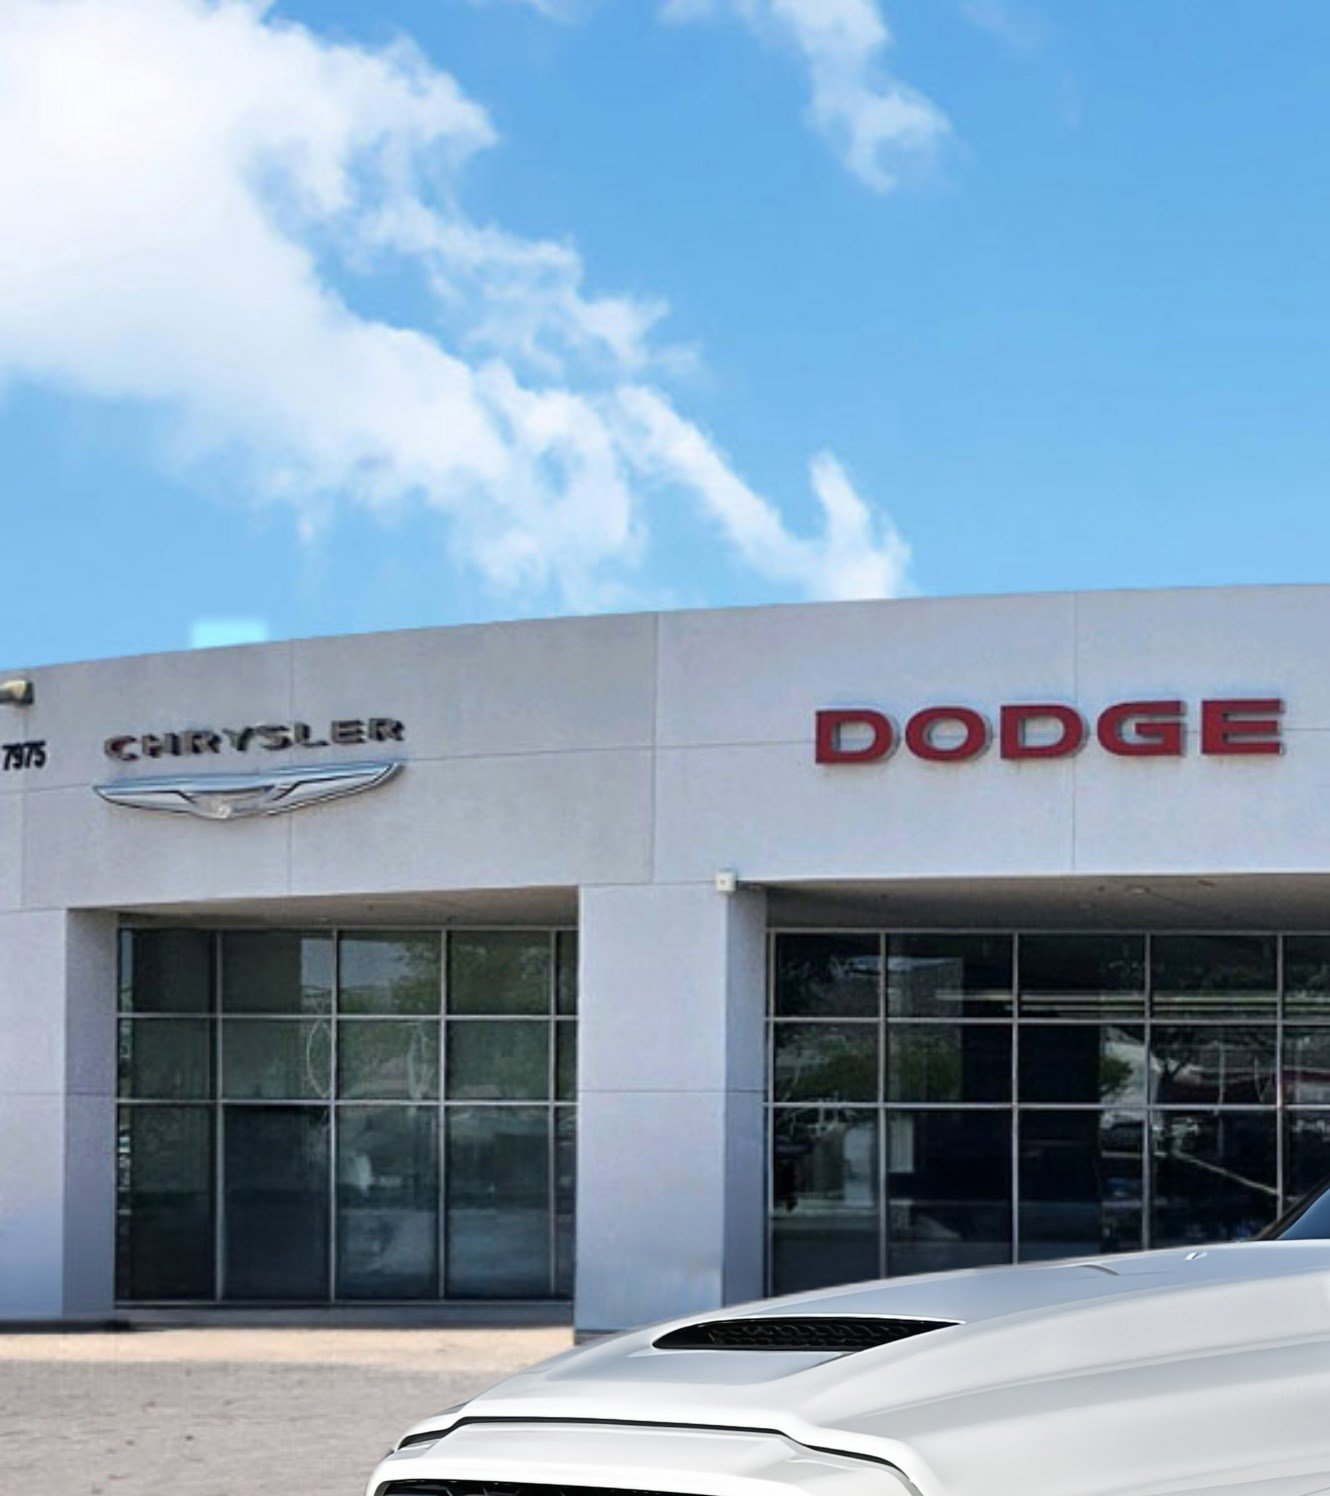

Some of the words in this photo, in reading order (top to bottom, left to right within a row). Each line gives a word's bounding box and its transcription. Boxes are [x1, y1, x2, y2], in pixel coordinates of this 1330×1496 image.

[104, 717, 406, 762] CHRYSLER
[815, 697, 1285, 764] DODGE
[2, 741, 47, 771] 7975
